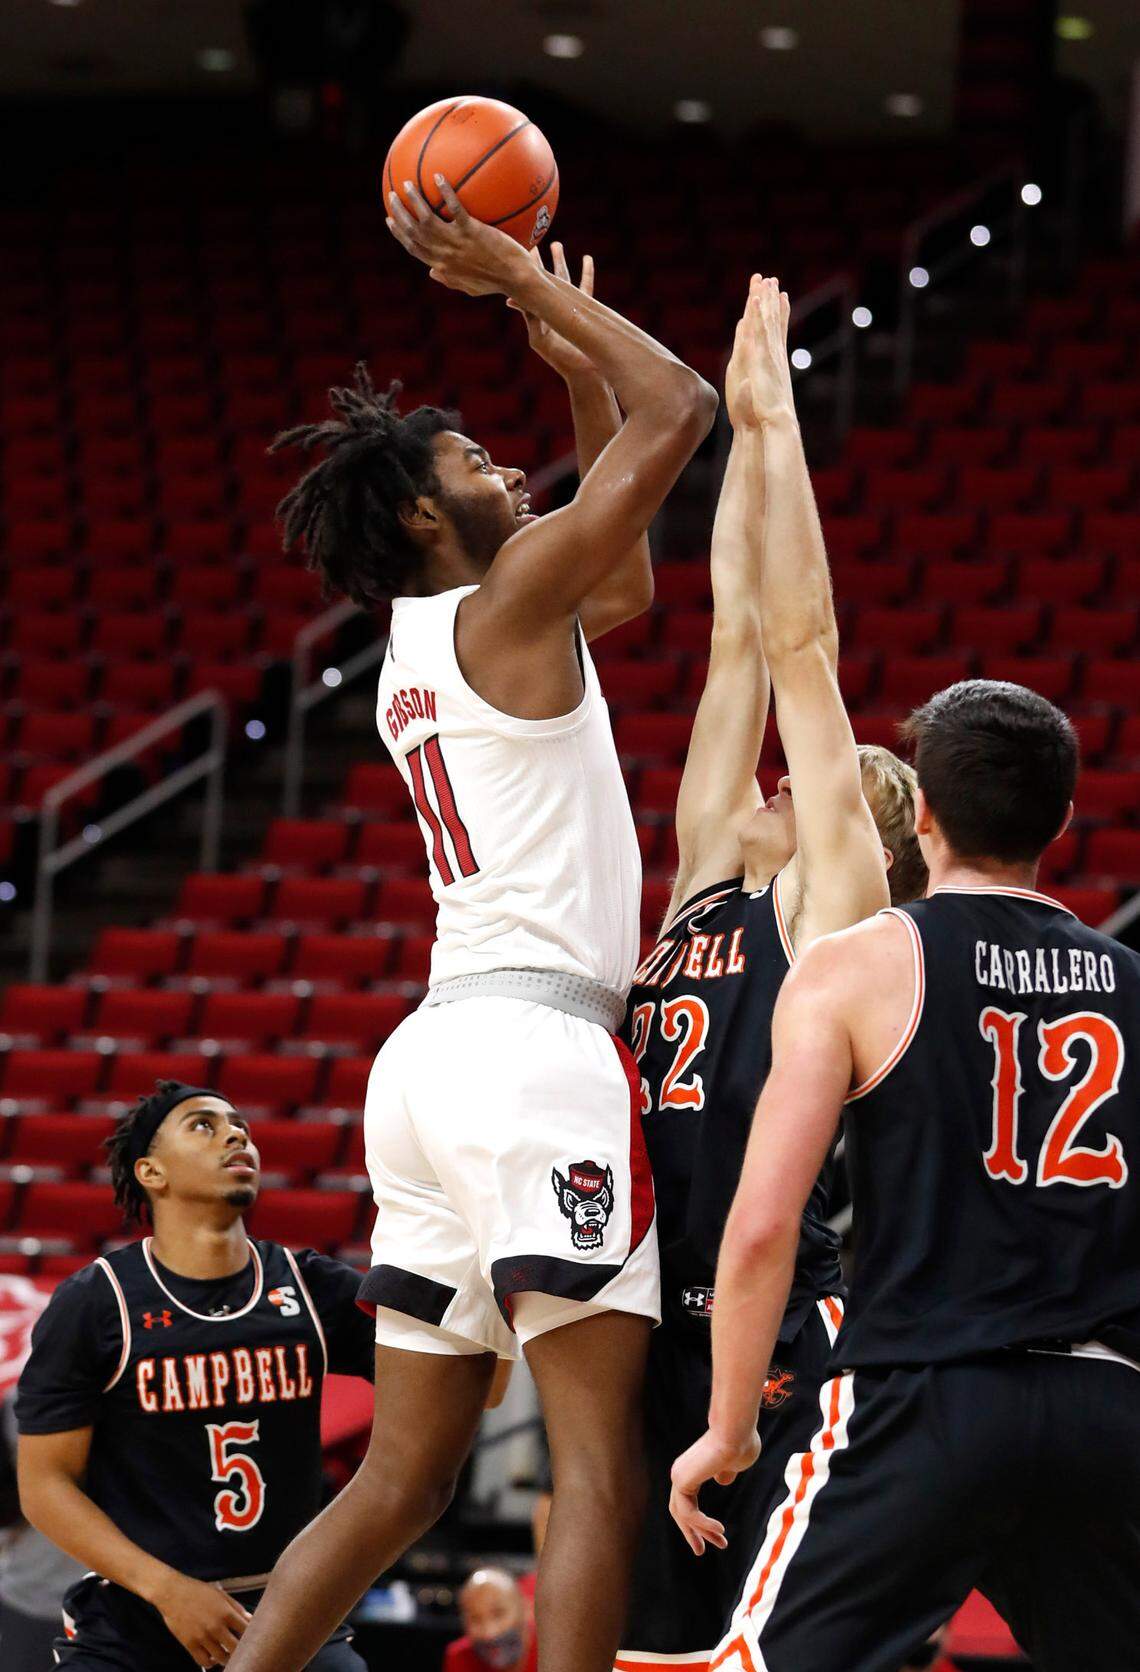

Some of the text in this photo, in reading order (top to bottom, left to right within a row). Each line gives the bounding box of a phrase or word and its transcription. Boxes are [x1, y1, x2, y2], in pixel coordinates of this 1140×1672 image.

[405, 733, 480, 887] 11
[975, 940, 1116, 995] CARRALERO
[978, 1006, 1129, 1189] 12
[573, 1175, 600, 1189] NC STATE
[137, 1344, 313, 1412] CAMPBELL
[205, 1418, 267, 1532] 5
